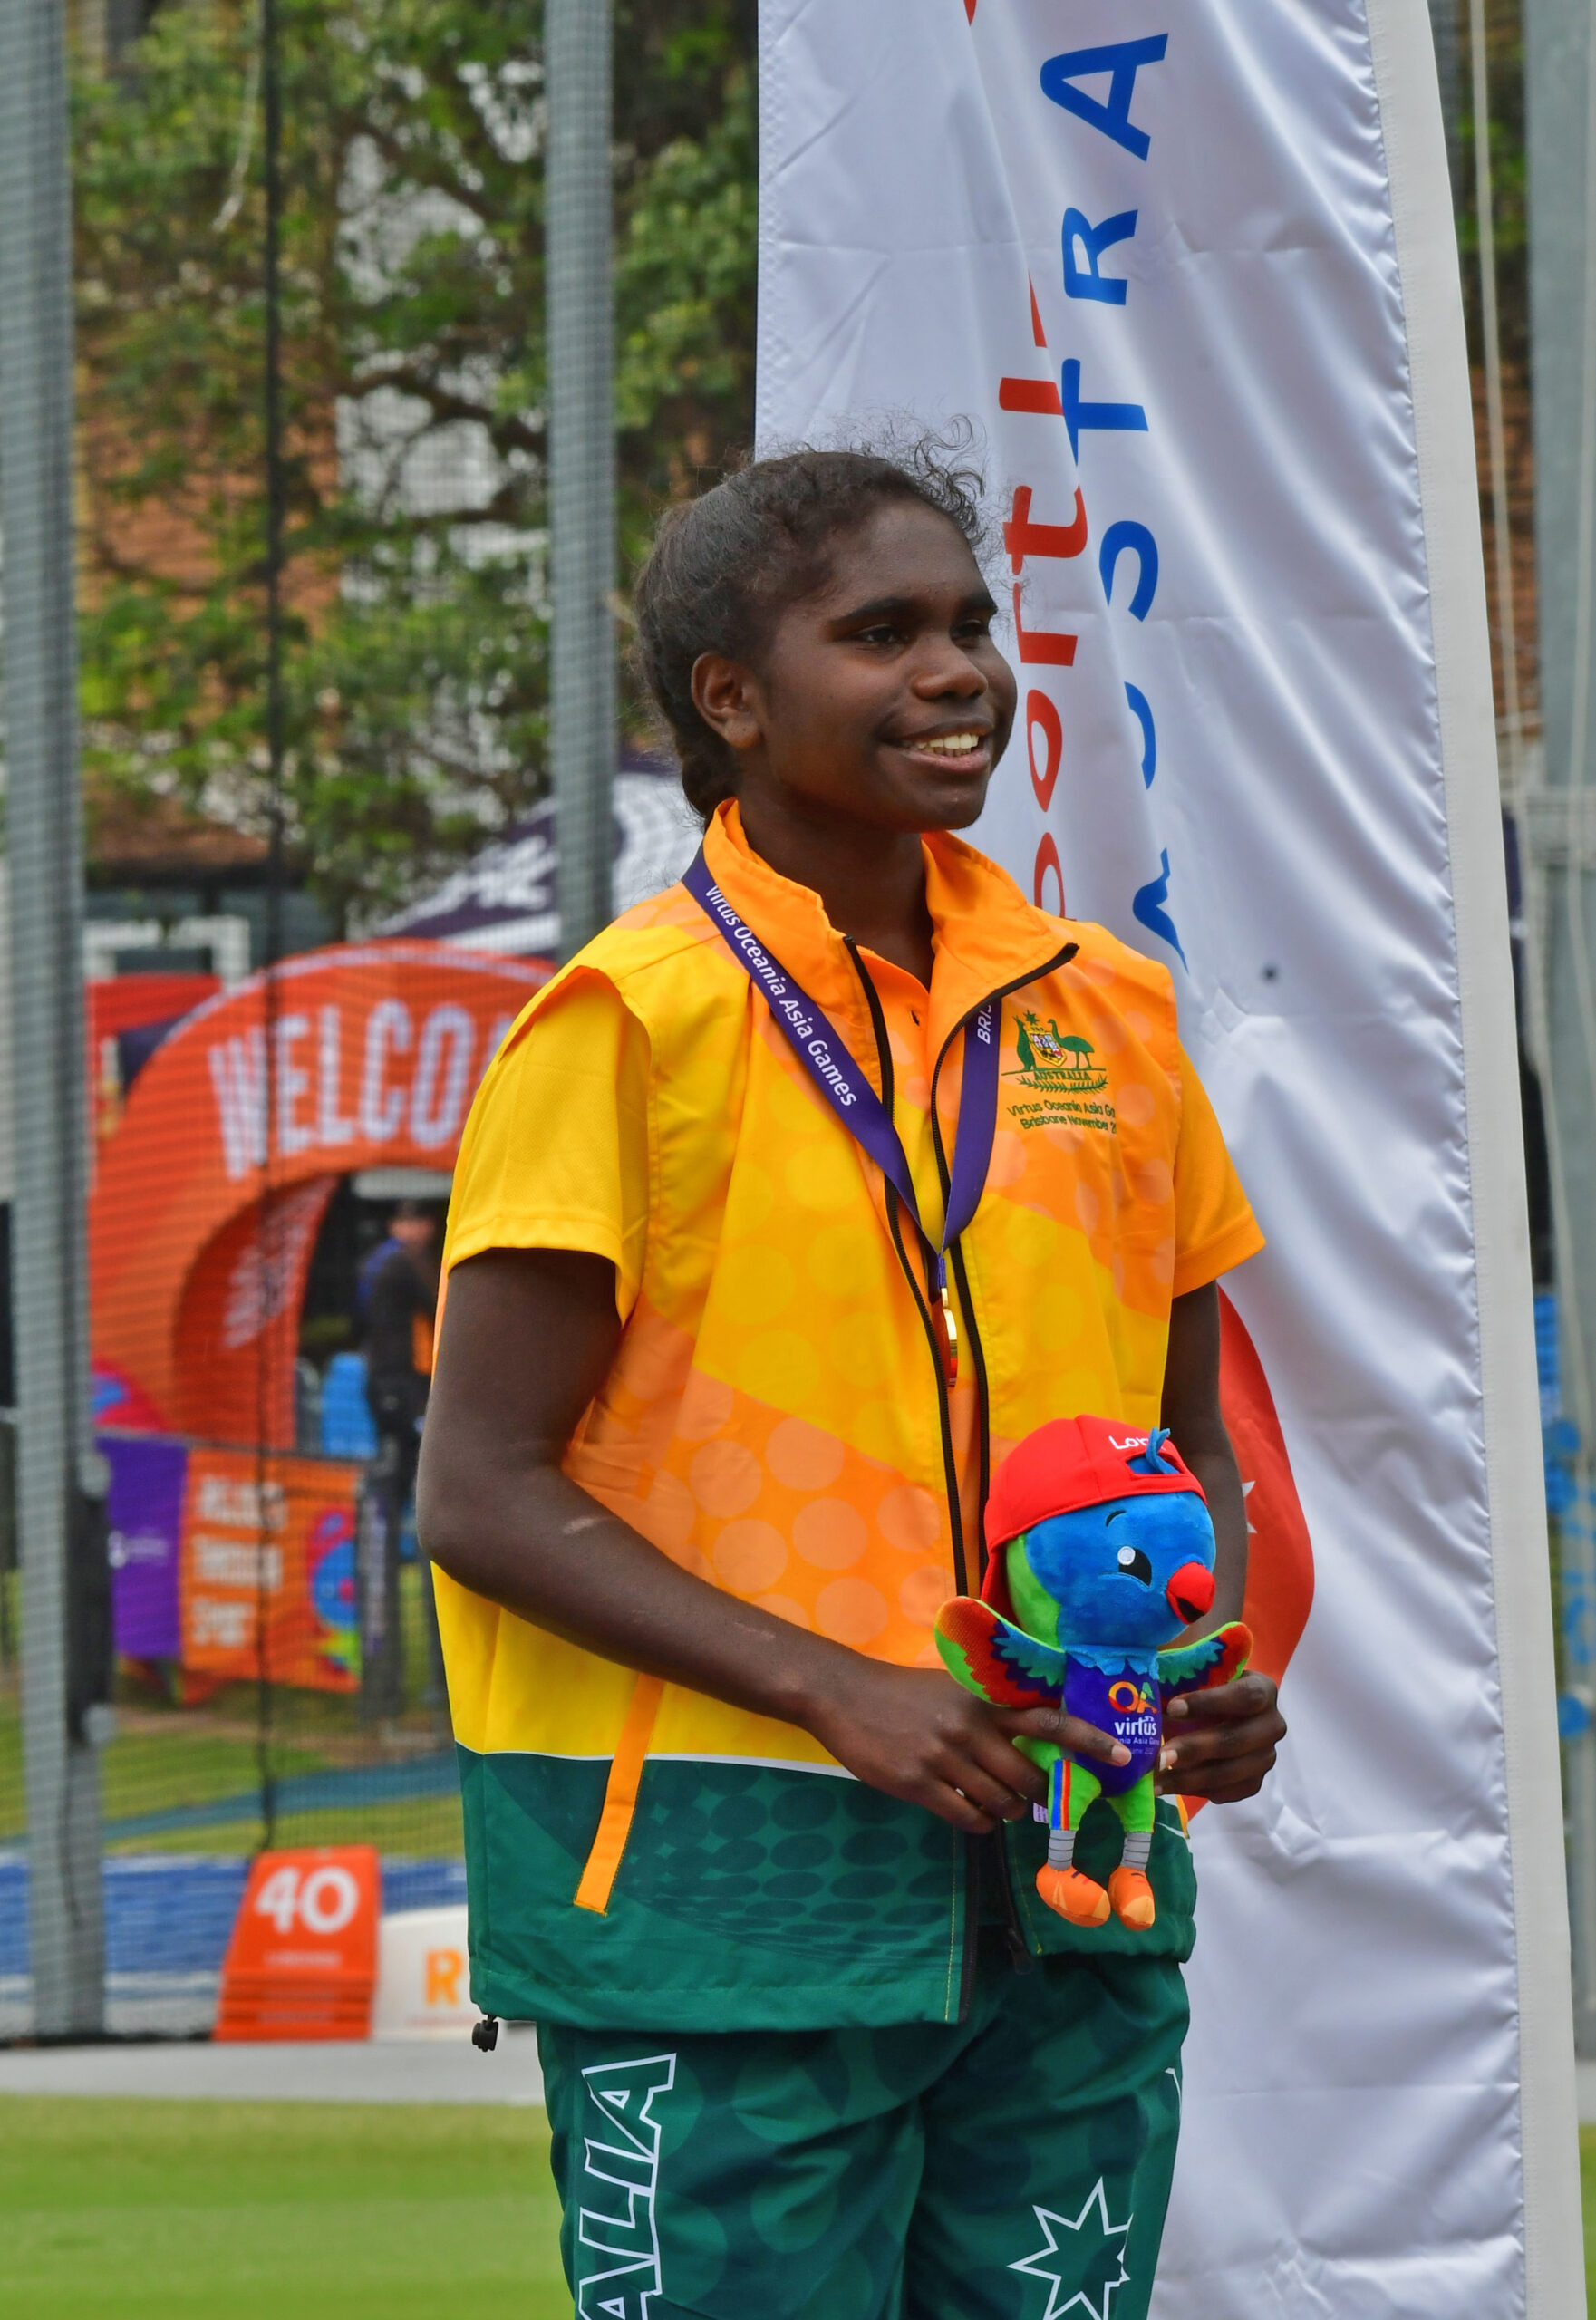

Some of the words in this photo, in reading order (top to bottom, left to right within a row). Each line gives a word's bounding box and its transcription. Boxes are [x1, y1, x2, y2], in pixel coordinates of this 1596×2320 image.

[705, 885, 740, 926] Virtus
[734, 926, 787, 995] Oceania
[779, 999, 813, 1039] Asia
[808, 1039, 857, 1107] Games
[1033, 1070, 1091, 1081] AUSTRALIA
[1007, 1103, 1043, 1116] Virtus
[1044, 1100, 1082, 1113] Oceania
[1084, 1102, 1104, 1116] Asia
[1020, 1115, 1067, 1129] Brisbane
[1067, 1115, 1108, 1130] November
[1114, 1716, 1156, 1735] virtus
[256, 1867, 359, 1934] 40
